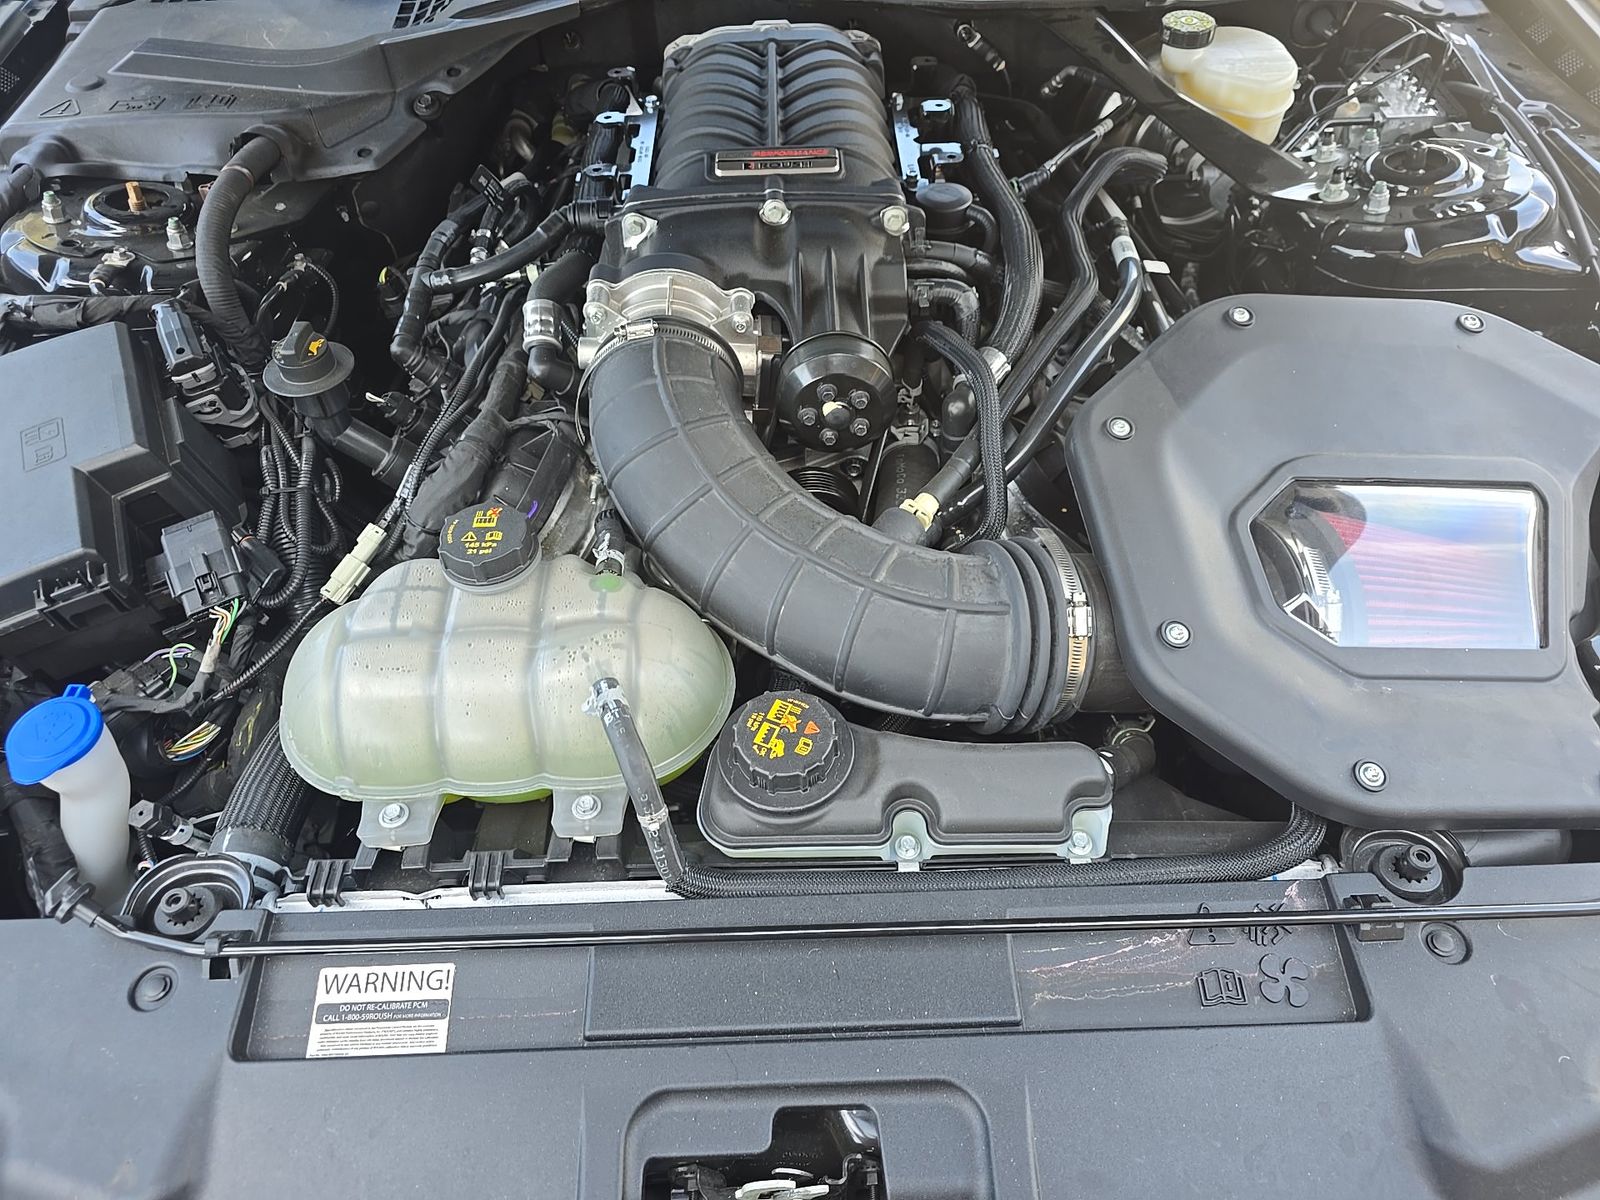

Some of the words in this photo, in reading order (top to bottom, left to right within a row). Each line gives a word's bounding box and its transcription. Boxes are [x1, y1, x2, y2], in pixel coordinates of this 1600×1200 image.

[324, 968, 451, 995] WARNING!
[339, 1004, 350, 1012] DO
[351, 1003, 366, 1011] NOT
[366, 1001, 412, 1011] RE-CALIBRATE
[412, 1001, 428, 1009] PCM
[322, 1014, 340, 1022] CALL
[341, 1012, 393, 1021] 1-800-59ROUSH
